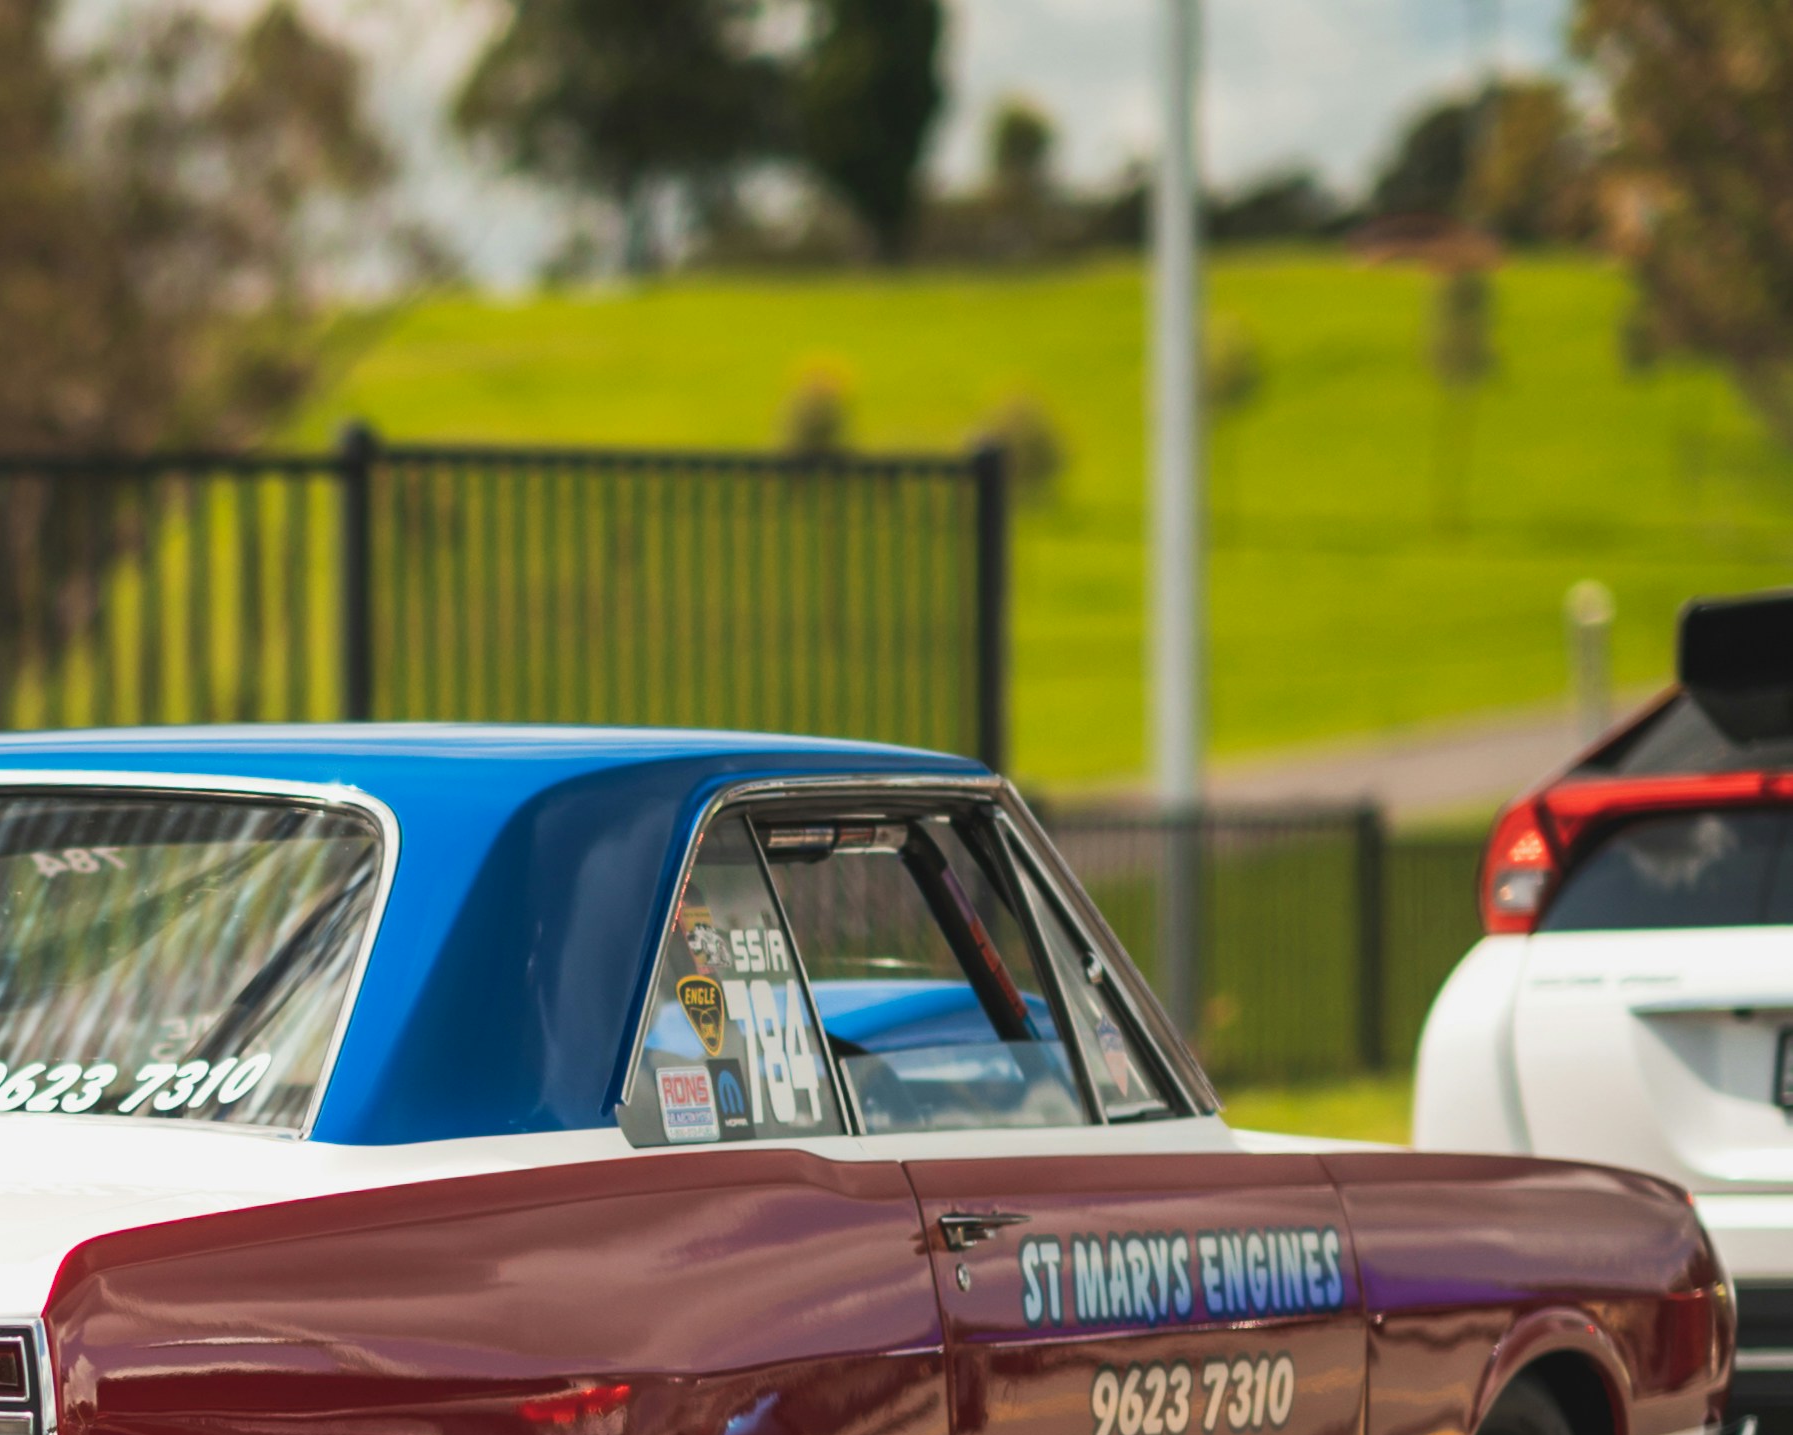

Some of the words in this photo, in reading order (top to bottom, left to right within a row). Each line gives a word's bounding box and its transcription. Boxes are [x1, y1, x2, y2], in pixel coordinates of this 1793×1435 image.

[684, 987, 716, 1005] ENGLE
[117, 1052, 272, 1113] 7310
[721, 979, 823, 1124] 784
[661, 1074, 710, 1105] RONS
[1020, 1237, 1062, 1326] ST
[1072, 1234, 1193, 1324] MARYS
[1198, 1228, 1344, 1317] ENGINES
[1202, 1355, 1295, 1431] 7310
